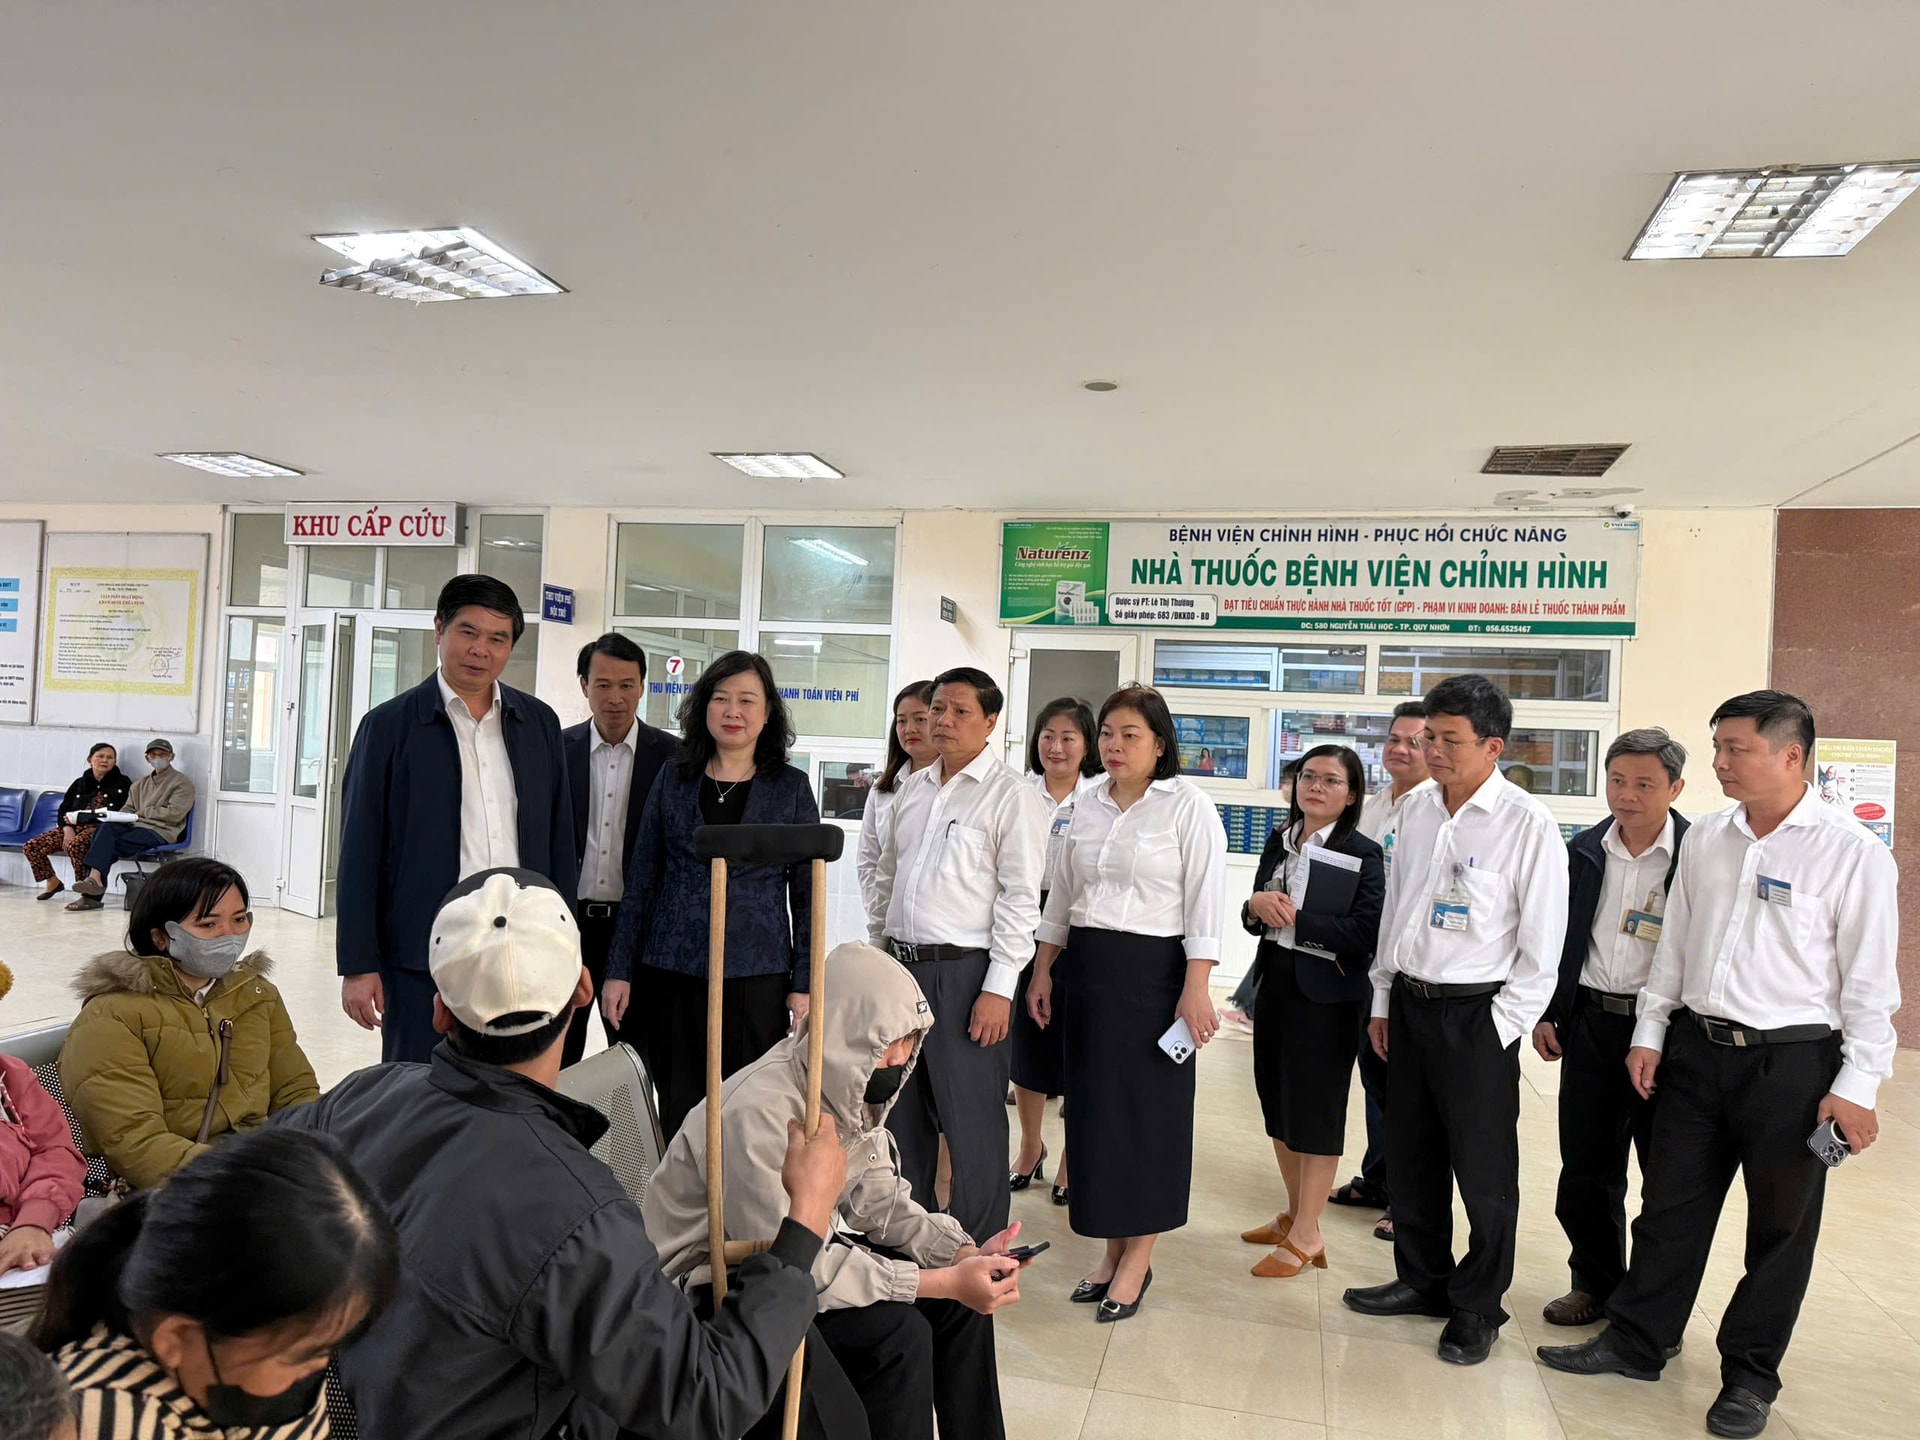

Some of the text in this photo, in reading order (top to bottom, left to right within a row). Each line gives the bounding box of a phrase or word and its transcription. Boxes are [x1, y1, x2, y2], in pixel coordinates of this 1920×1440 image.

[292, 505, 447, 537] KHU CẤP CỨU
[1169, 524, 1212, 545] BỆNH
[1217, 524, 1255, 545] VIỆN
[1259, 524, 1312, 542] CHỈNH
[1317, 524, 1359, 542] HÌNH
[1374, 528, 1420, 545] PHỤC
[1425, 522, 1454, 543] HỒI
[1460, 524, 1508, 543] CHỨC
[1514, 525, 1567, 543] NĂNG
[1016, 545, 1091, 560] Naturenz
[1131, 548, 1608, 596] NHÀ THUỐC BỆNH VIỆN CHỈNH HÌNH
[1224, 598, 1239, 612] ĐẠT
[1241, 597, 1258, 610] TIÊU
[1260, 594, 1285, 611] CHUẨN
[1286, 599, 1307, 613] THỰC
[1308, 598, 1329, 612] HÀNH
[1331, 598, 1347, 612] NHÀ
[1349, 596, 1375, 612] THUỐC
[1377, 596, 1392, 612] TỐT
[1394, 600, 1415, 614] (GPP)
[1423, 601, 1446, 615] PHẠM
[1447, 602, 1456, 613] VI
[1457, 601, 1477, 614] KINH
[1479, 602, 1508, 614] DOANH:
[1511, 599, 1528, 614] BÁN
[1542, 599, 1570, 615] THUỐC
[1572, 600, 1599, 615] THÀNH
[1601, 597, 1626, 615] PHẨM
[1157, 611, 1170, 619] 683
[1329, 620, 1358, 630] NGUYỄN
[1400, 623, 1411, 631] TP.
[670, 659, 681, 673] 7
[649, 682, 663, 693] THU
[665, 681, 682, 696] VIỆN
[803, 686, 823, 700] TOÁN
[825, 687, 843, 703] VIỆN
[845, 687, 860, 702] PHÍ
